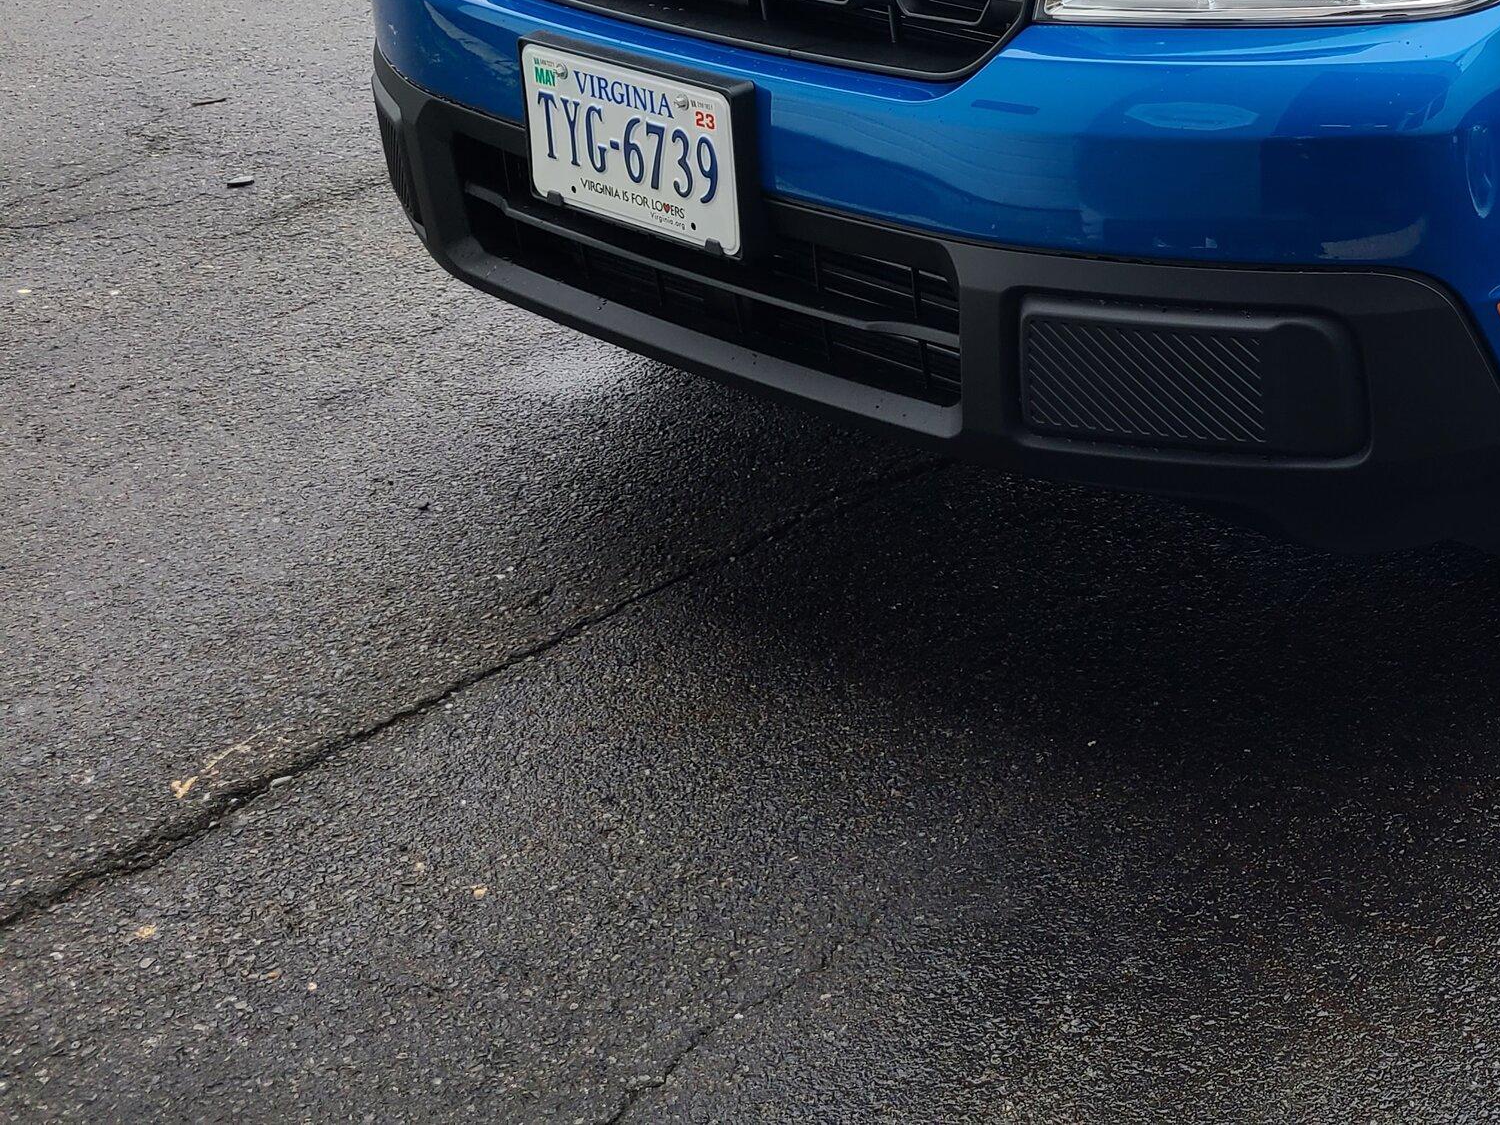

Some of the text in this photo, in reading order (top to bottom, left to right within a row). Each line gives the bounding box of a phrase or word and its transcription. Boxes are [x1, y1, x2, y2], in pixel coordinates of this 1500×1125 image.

[534, 66, 556, 87] MAY
[573, 70, 675, 119] VIRGINIA
[695, 110, 716, 130] 23
[537, 90, 719, 204] TYG-6739
[580, 178, 621, 200] VIRGINIA
[621, 190, 630, 202] IS
[631, 192, 650, 209] FOR
